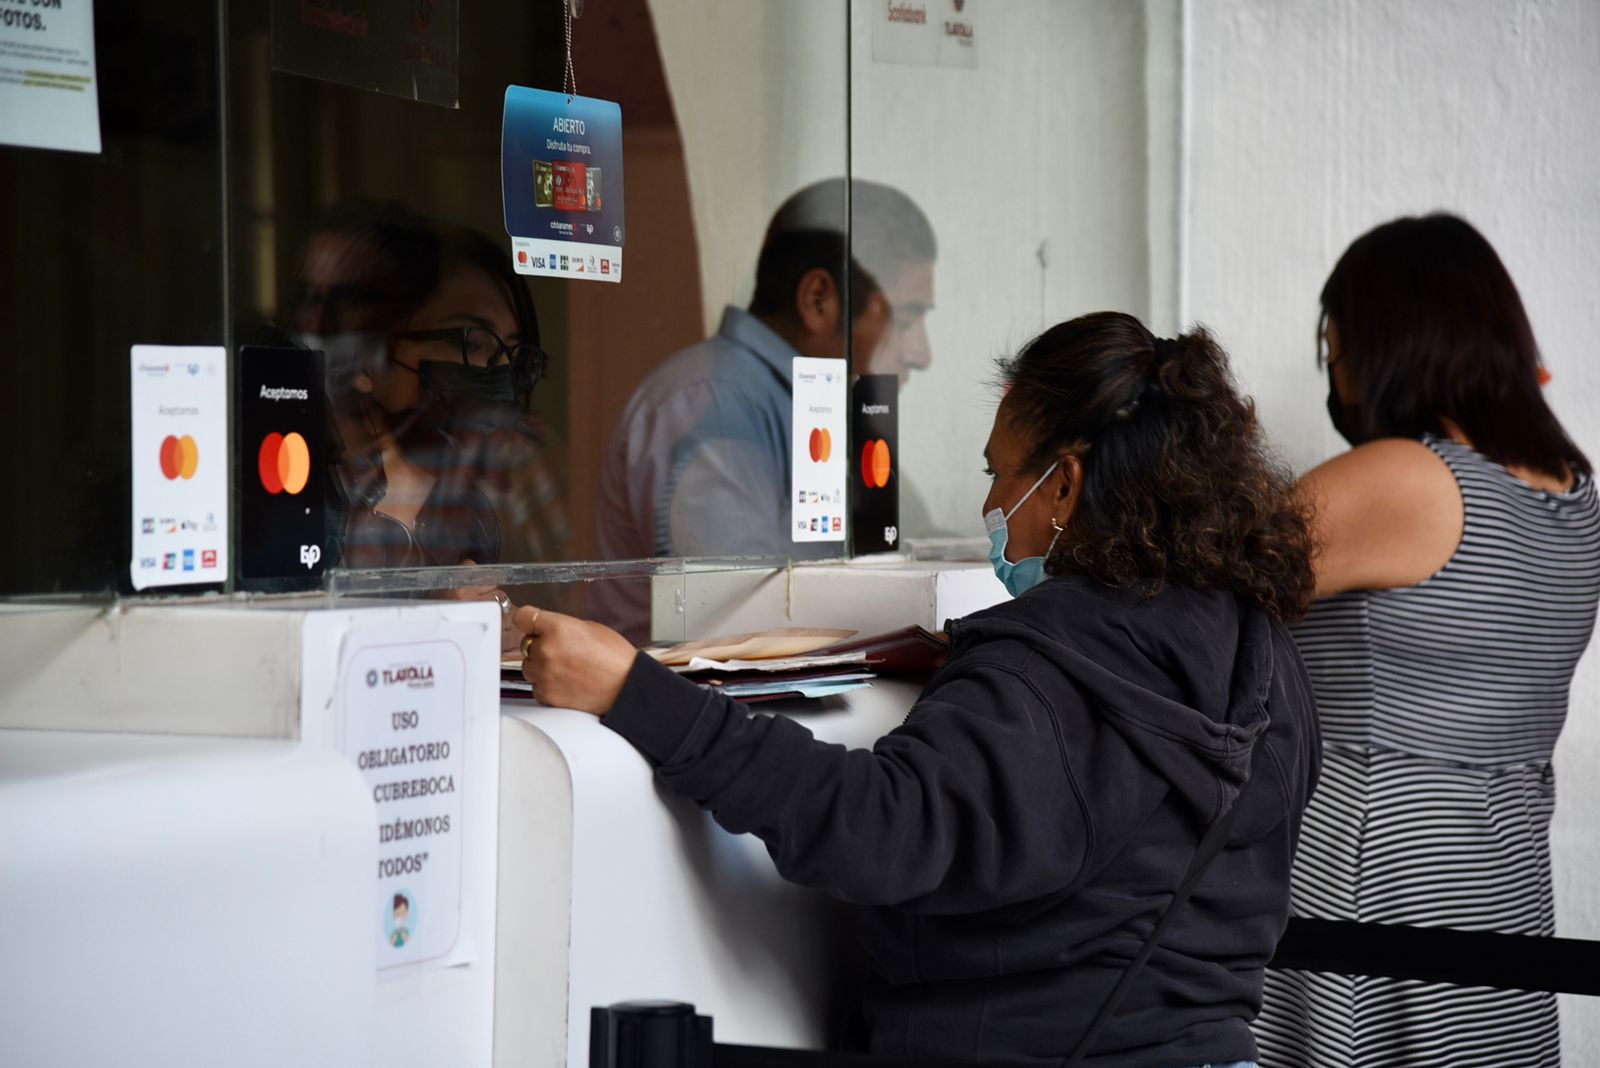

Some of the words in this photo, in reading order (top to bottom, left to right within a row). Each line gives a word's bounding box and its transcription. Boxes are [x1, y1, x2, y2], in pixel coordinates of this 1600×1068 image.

[553, 117, 585, 135] ABIERTO
[546, 139, 567, 151] Disfruta
[531, 257, 546, 269] VISA
[260, 384, 308, 402] Aceptamos
[392, 710, 419, 730] USO
[358, 741, 450, 770] OBLIGATORIO
[373, 776, 455, 803] CUBREBOCA
[379, 815, 450, 843] IDÉMONOS
